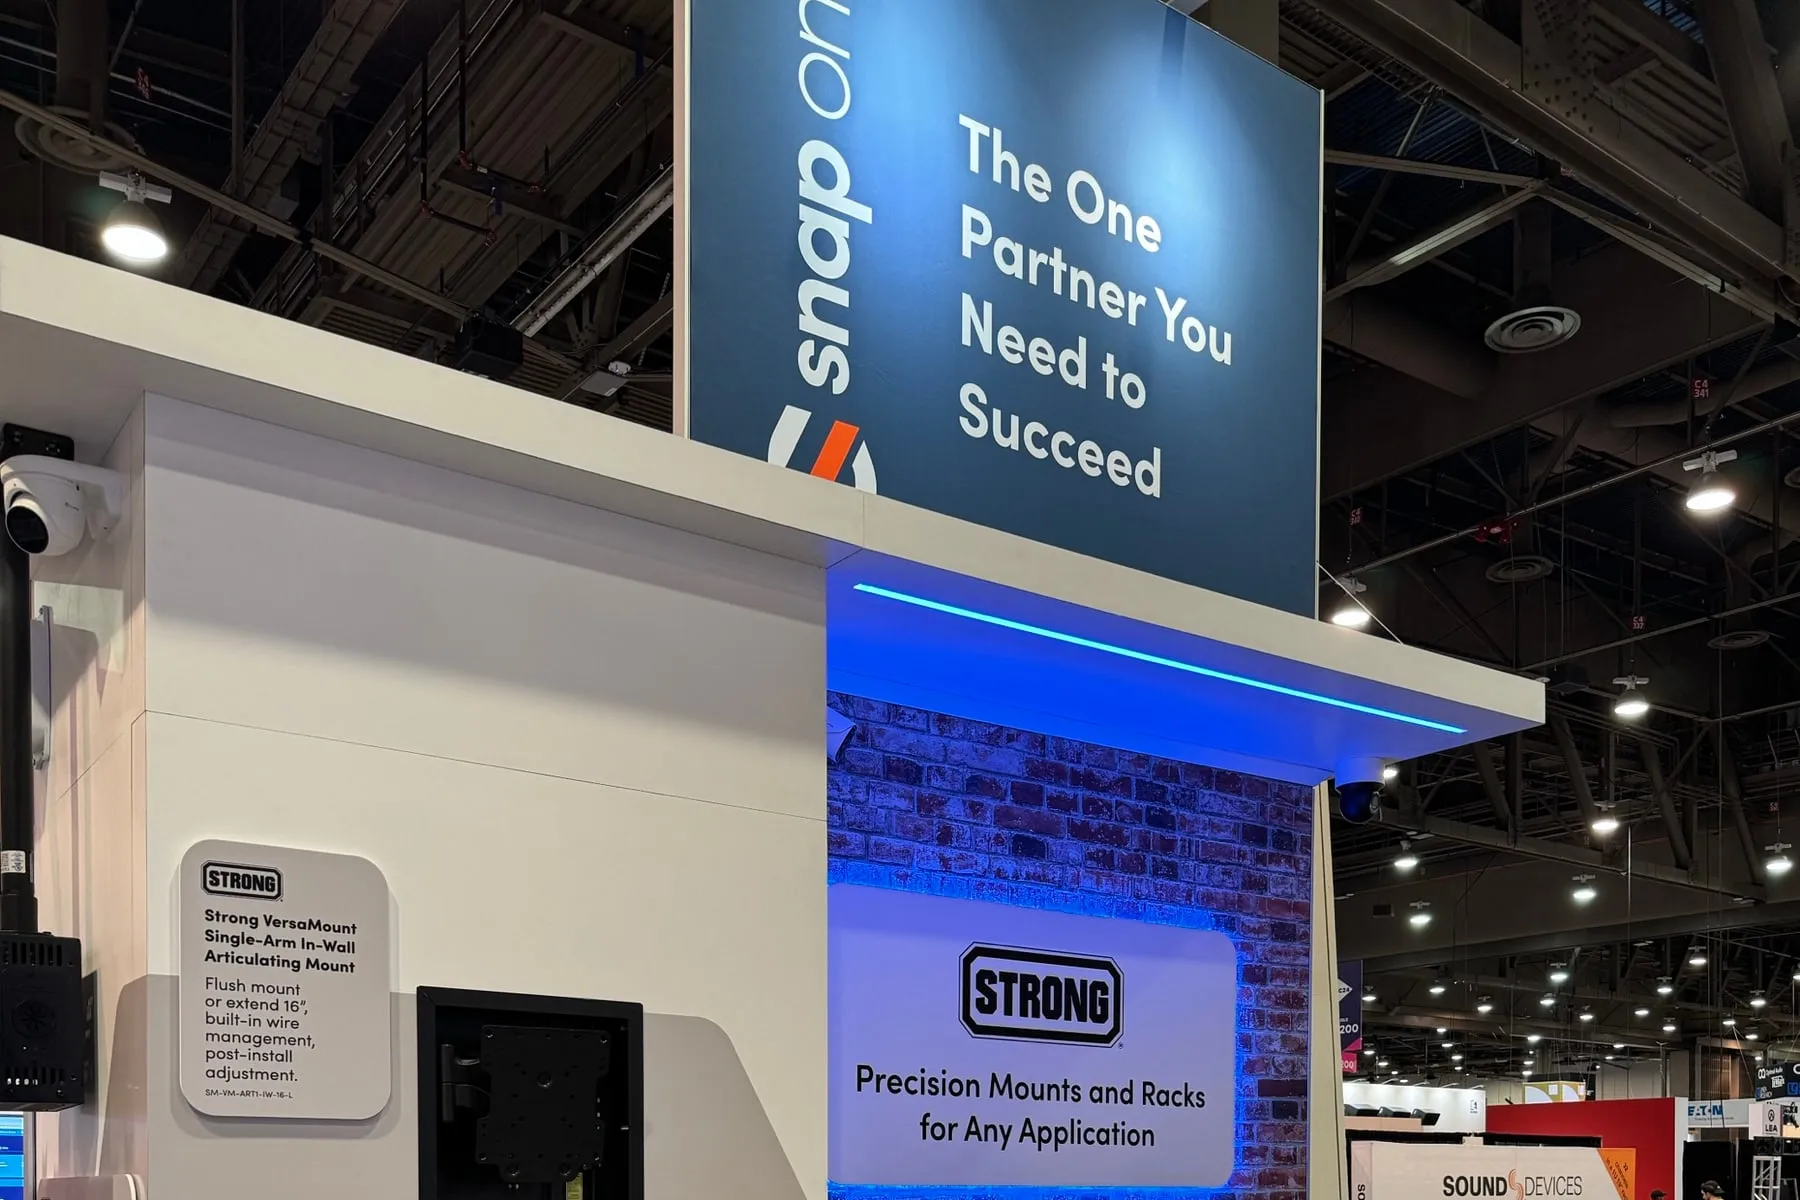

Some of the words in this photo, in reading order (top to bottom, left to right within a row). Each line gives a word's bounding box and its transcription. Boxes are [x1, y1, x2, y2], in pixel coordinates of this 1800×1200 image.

[959, 114, 1052, 203] The
[1066, 170, 1161, 253] One
[798, 140, 873, 395] snap
[961, 204, 1146, 326] Partner
[1155, 288, 1232, 366] You
[961, 293, 1087, 390] Need
[1102, 352, 1146, 410] to
[959, 383, 1162, 499] Succeed
[208, 869, 276, 893] STRONG
[204, 909, 259, 929] Strong
[263, 914, 358, 935] VersaMount
[204, 929, 297, 950] Single-Arm
[301, 937, 356, 954] In-Wall
[204, 949, 301, 973] Articulating
[305, 957, 356, 973] Mount
[205, 977, 246, 993] Flush
[251, 981, 301, 996] mount
[974, 968, 1109, 1025] STRONG
[205, 997, 222, 1008] or
[226, 997, 279, 1012] extend
[205, 1012, 262, 1028] built-in
[267, 1016, 300, 1030] wire
[205, 1032, 315, 1050] management,
[205, 1049, 293, 1063] post-install
[205, 1066, 298, 1083] adjustment.
[856, 1064, 981, 1099] Precision
[989, 1072, 1082, 1103] Mounts
[1089, 1079, 1133, 1106] and
[1142, 1081, 1206, 1109] Racks
[920, 1112, 959, 1142] for
[964, 1115, 1013, 1151] Any
[1018, 1117, 1156, 1152] Application
[1765, 1124, 1778, 1133] LEA
[1443, 1175, 1508, 1197] SOUND
[1524, 1175, 1583, 1197] DEVICES
